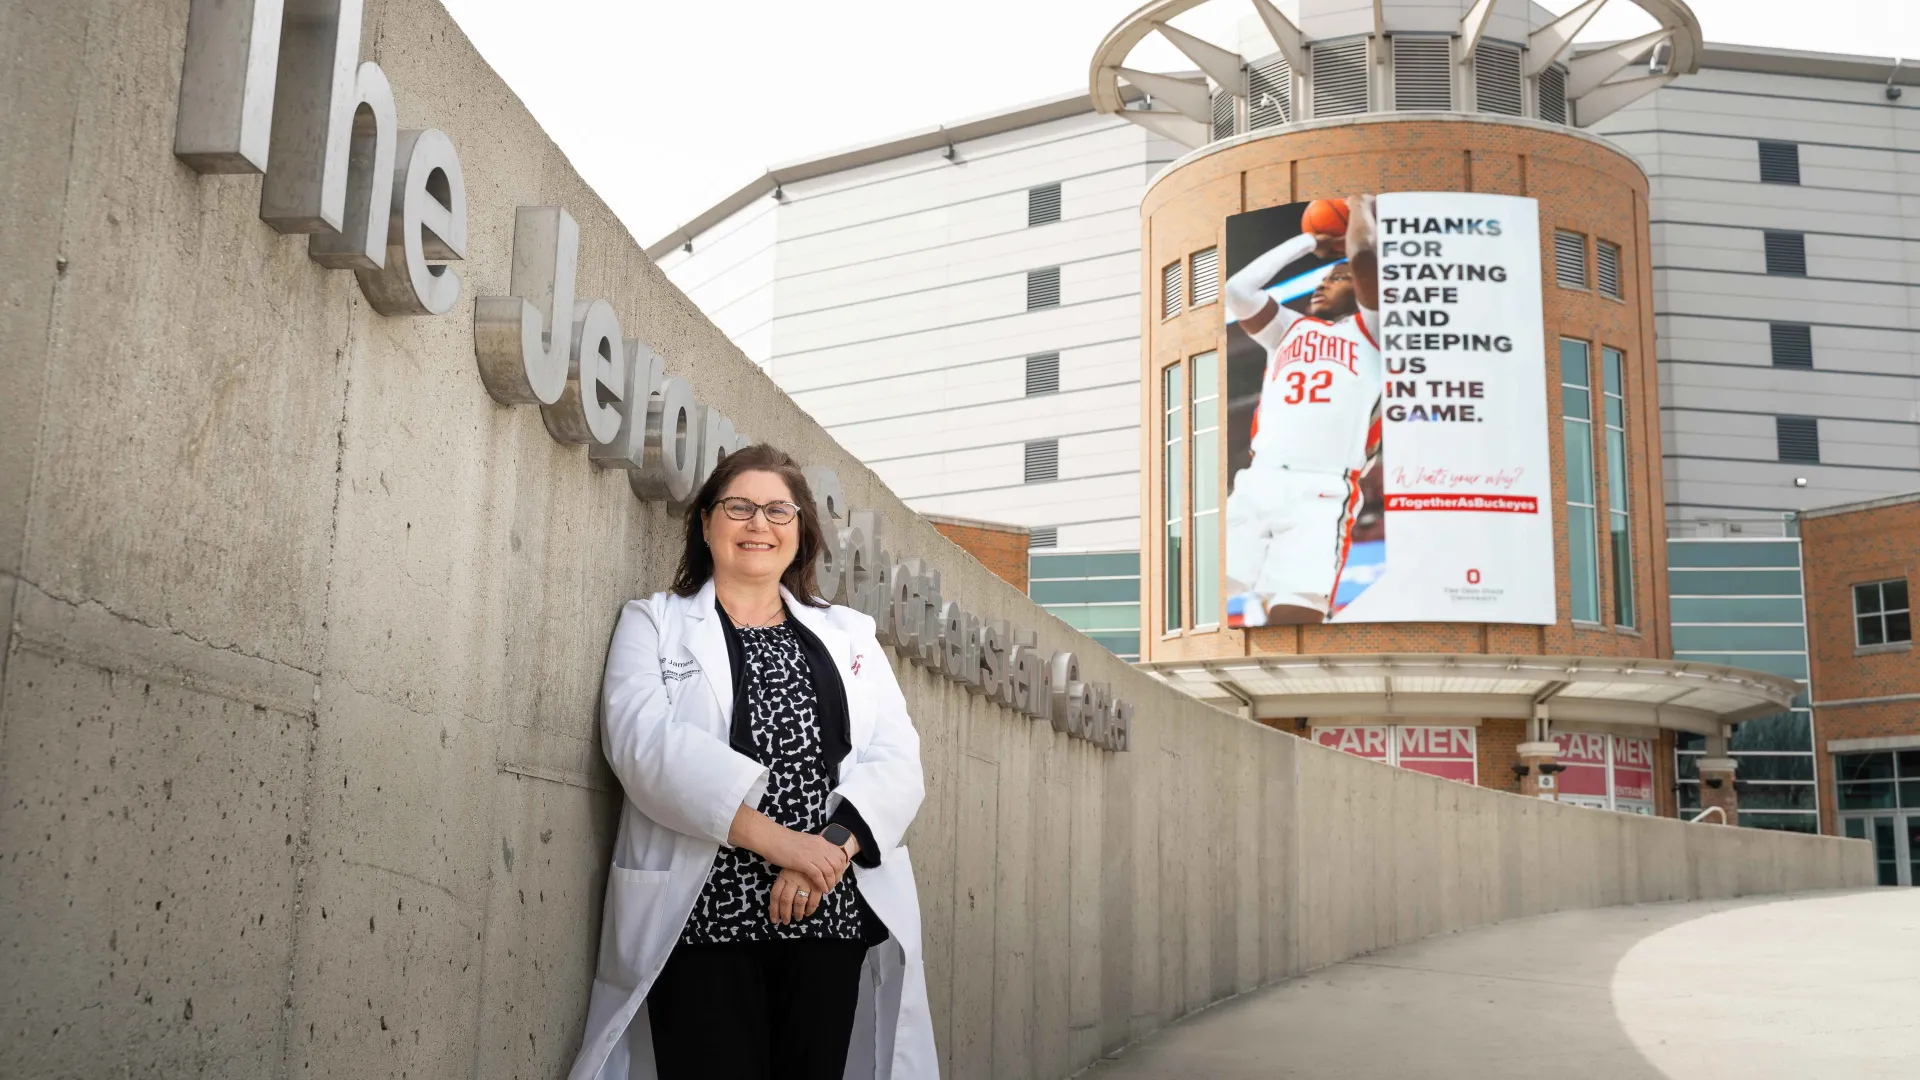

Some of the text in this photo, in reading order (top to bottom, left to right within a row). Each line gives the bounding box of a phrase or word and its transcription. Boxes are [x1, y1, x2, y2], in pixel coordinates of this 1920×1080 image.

[1381, 217, 1503, 237] THANKS
[1382, 240, 1443, 258] FOR
[1382, 263, 1508, 283] STAYING
[1383, 286, 1459, 304] SAFE
[1383, 310, 1450, 327] AND
[1385, 333, 1514, 353] KEEPING
[1304, 330, 1358, 377] STATE
[1385, 356, 1427, 375] US
[1283, 368, 1333, 405] 32
[1386, 381, 1485, 399] IN THE
[1386, 404, 1484, 423] GAME.
[1388, 496, 1536, 512] #TogetherAsBuckeyes
[668, 659, 694, 668] James
[1050, 652, 1134, 752] Center
